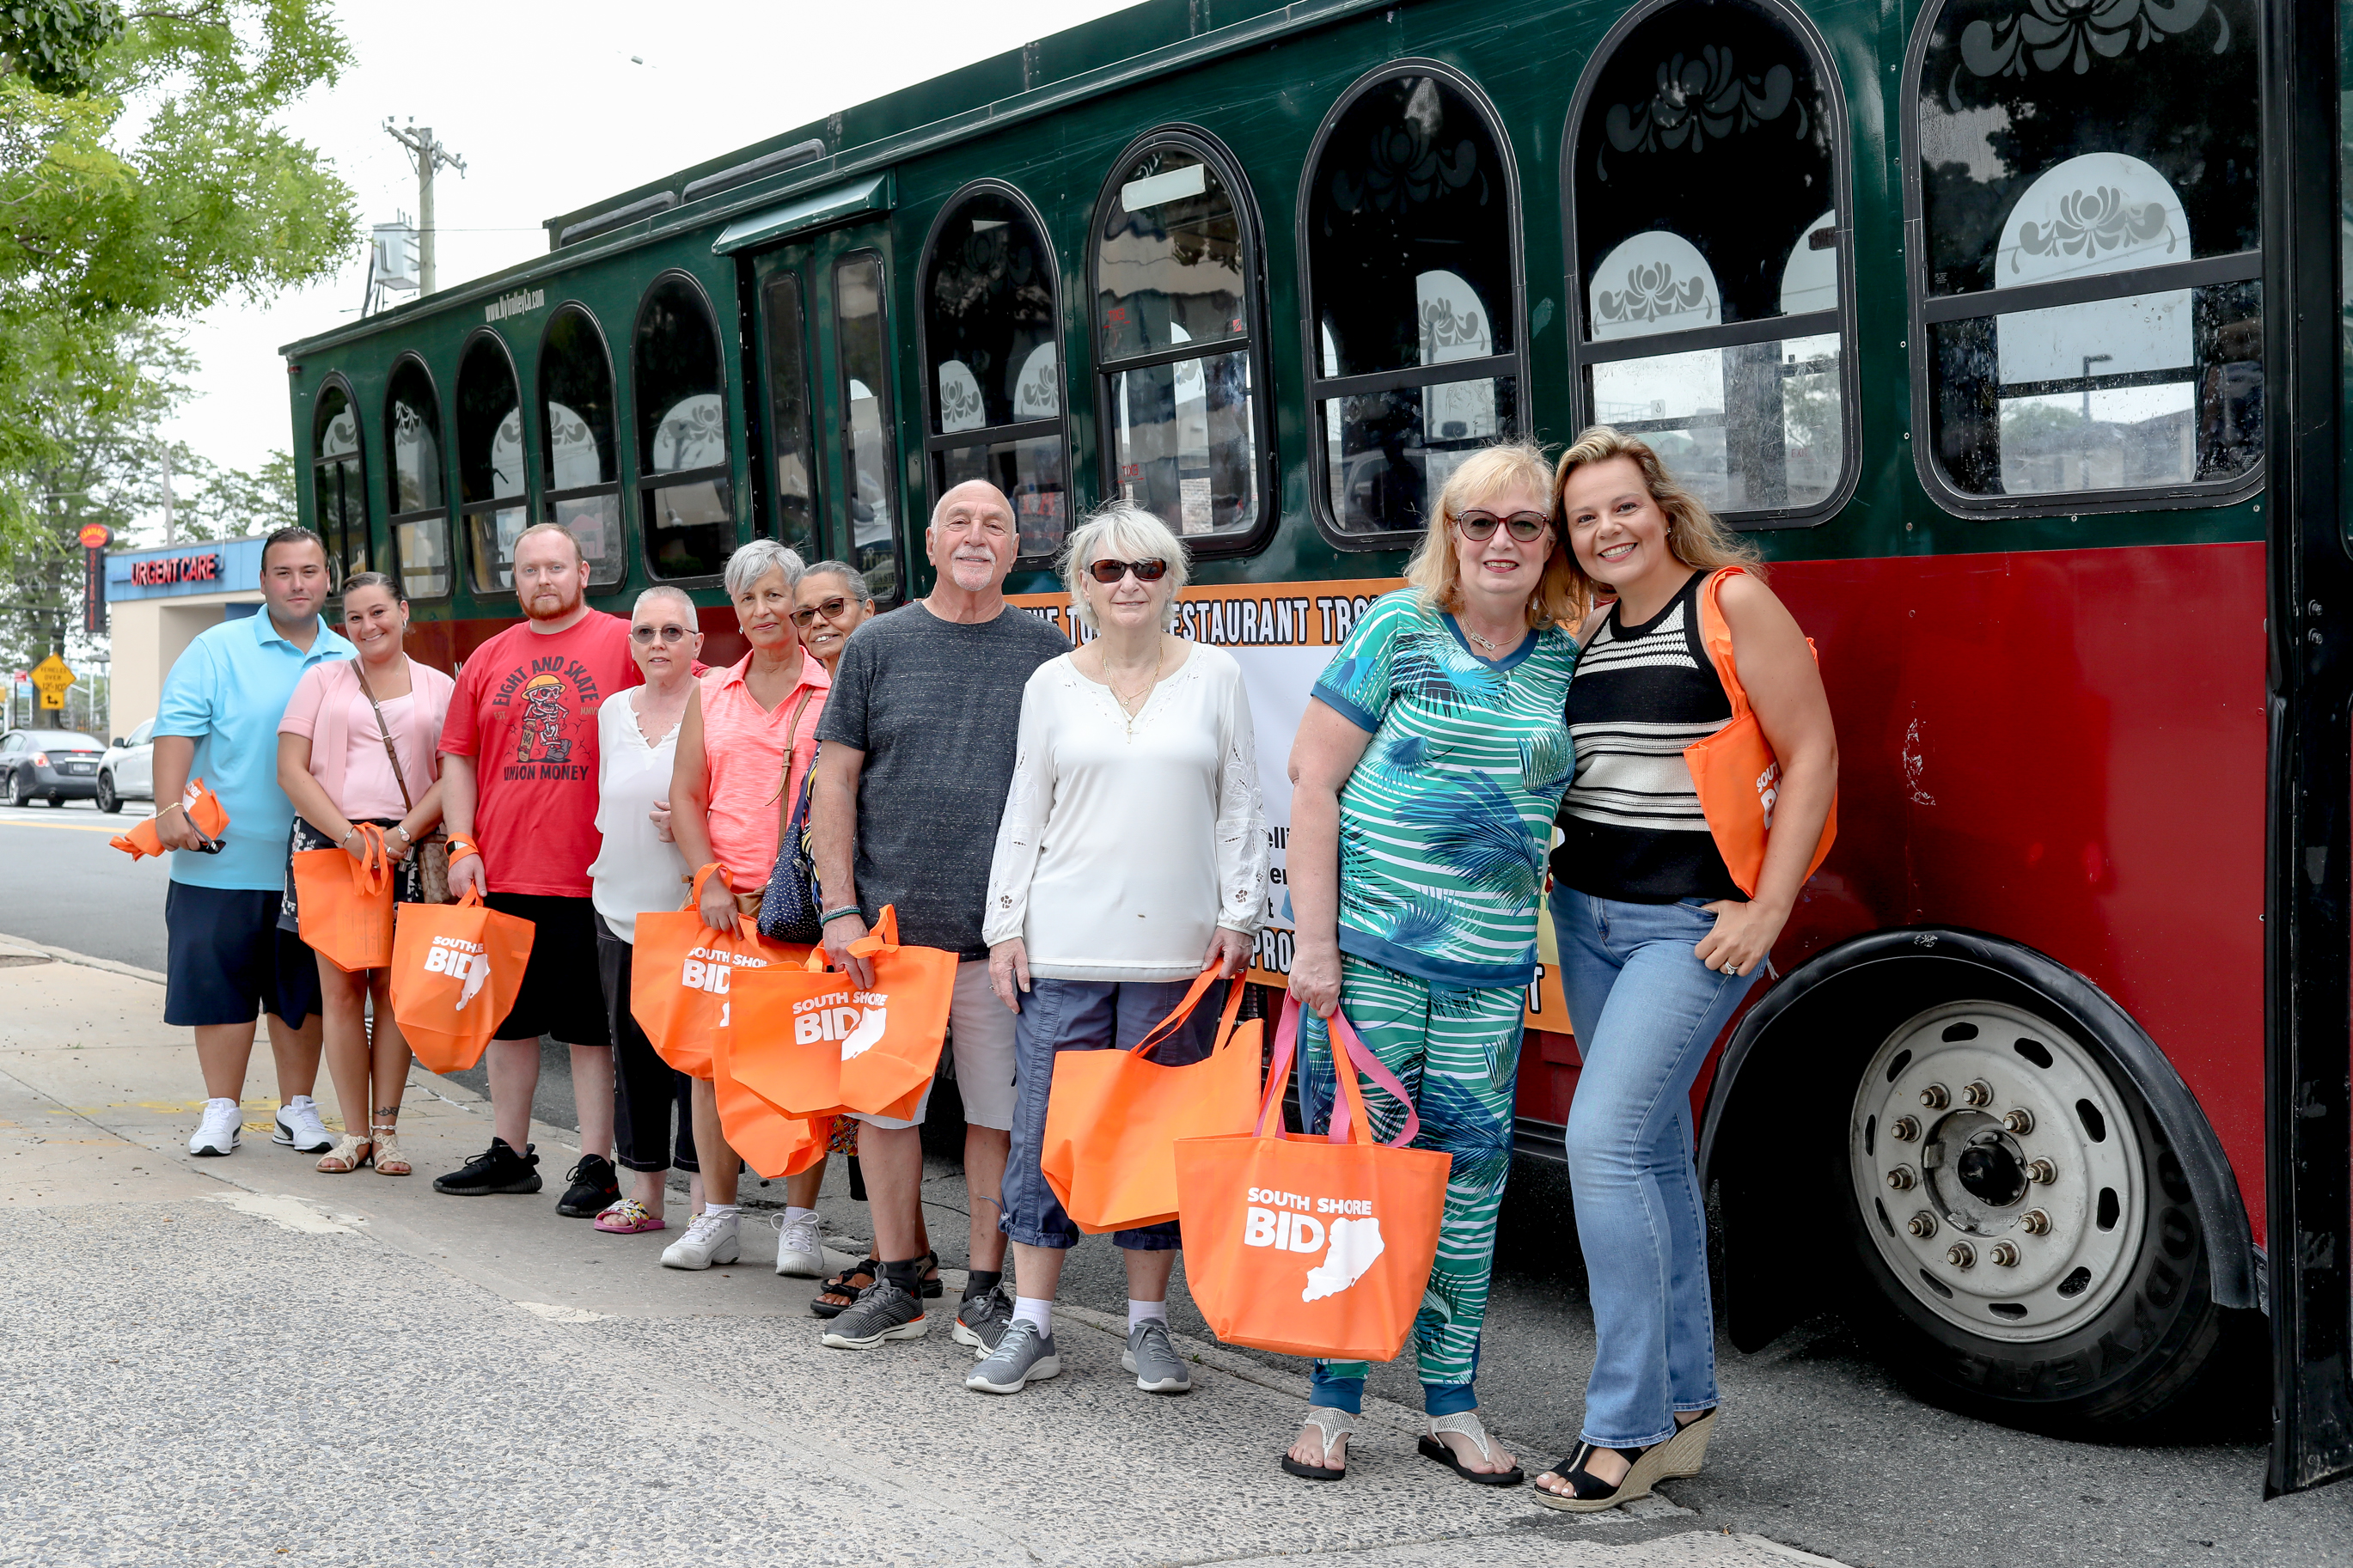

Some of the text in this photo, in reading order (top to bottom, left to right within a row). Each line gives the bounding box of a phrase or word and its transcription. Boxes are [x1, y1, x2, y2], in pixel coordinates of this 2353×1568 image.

[131, 553, 216, 587] URGENT CARE
[1170, 598, 1311, 644] ESTAURANT
[1317, 595, 1379, 644] TRO
[492, 656, 600, 707] EIGHT AND SKATE
[504, 765, 590, 782] UNION MONEY
[1756, 761, 1779, 794] SOUT
[431, 935, 477, 954] SOUTH
[423, 946, 474, 980] BID
[681, 957, 730, 995] BID
[791, 991, 889, 1015] SOUTH SHORE
[794, 1006, 861, 1046] BID
[1247, 1187, 1372, 1216] SOUTH SHORE
[1244, 1206, 1325, 1254] BID
[1951, 1103, 2195, 1394] OODYEAR
